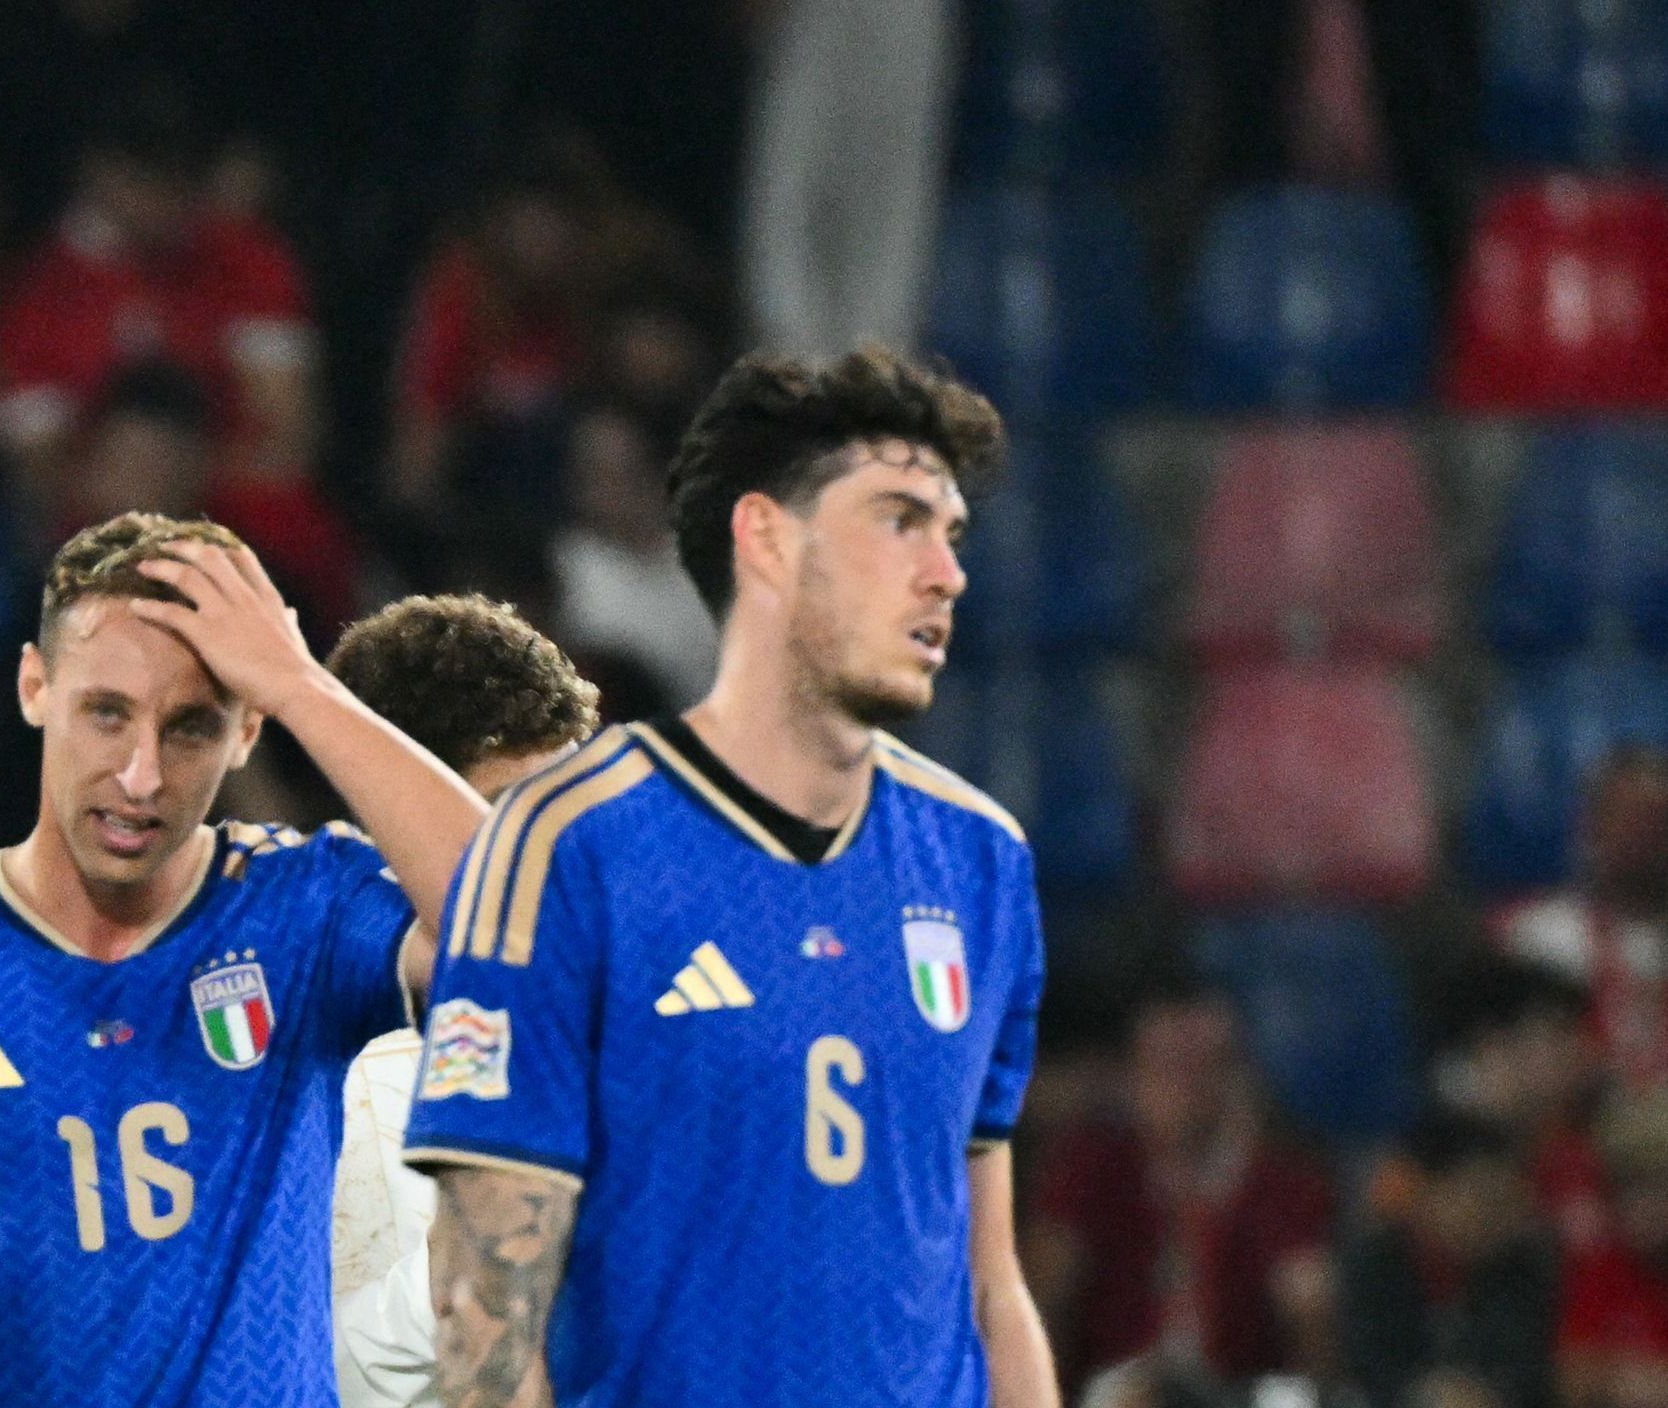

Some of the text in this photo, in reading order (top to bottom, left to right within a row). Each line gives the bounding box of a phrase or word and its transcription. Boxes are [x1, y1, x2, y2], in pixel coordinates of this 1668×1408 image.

[195, 972, 260, 1004] ITALIA
[57, 1101, 194, 1252] 16
[805, 1034, 865, 1186] 6
